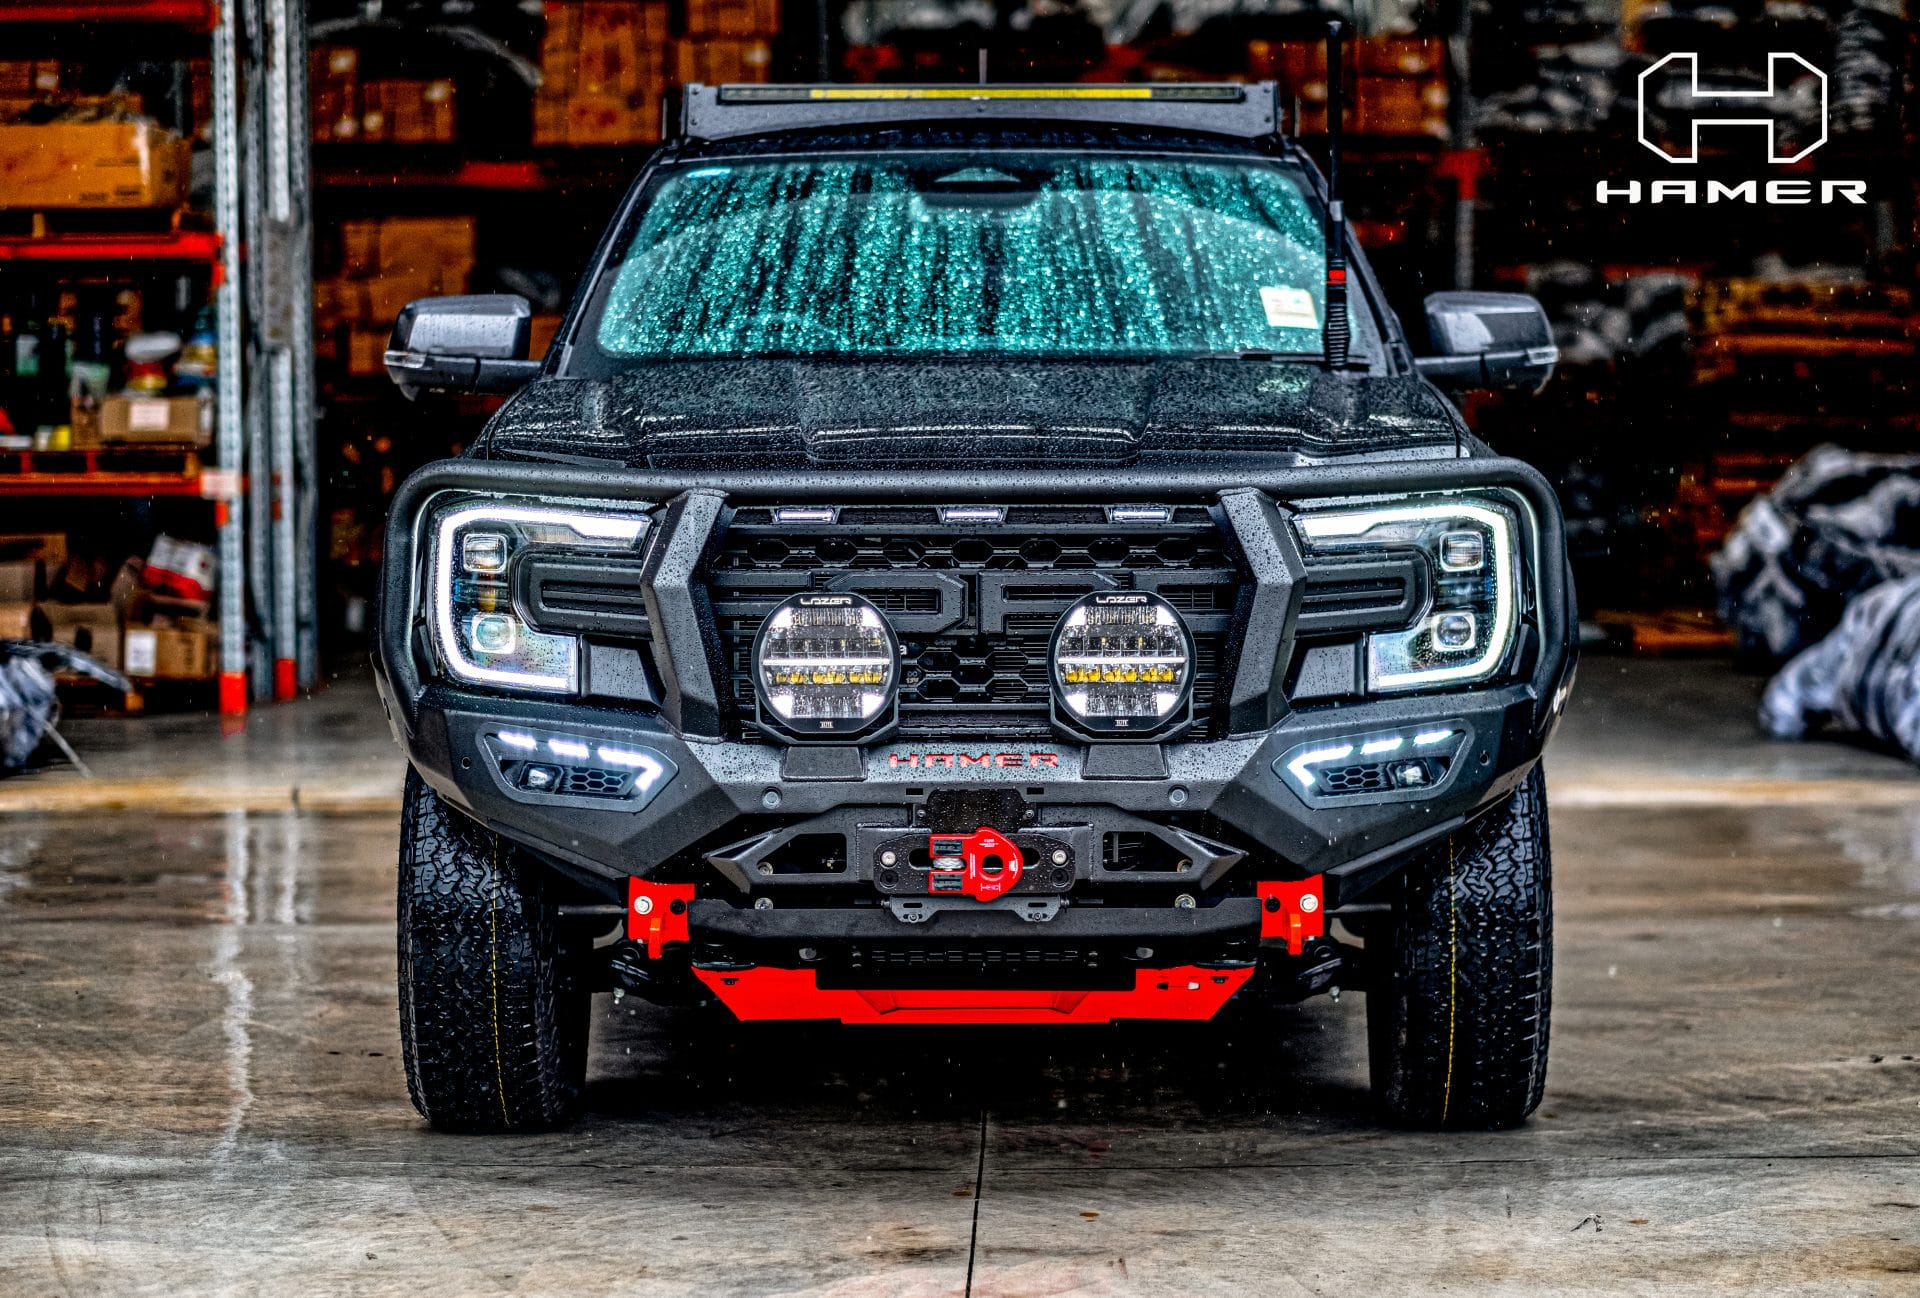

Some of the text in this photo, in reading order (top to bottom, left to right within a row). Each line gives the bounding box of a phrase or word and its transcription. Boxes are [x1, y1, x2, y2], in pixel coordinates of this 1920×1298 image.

[800, 596, 852, 606] LAZER
[1095, 595, 1148, 604] LAZER
[889, 753, 1057, 768] HAMER
